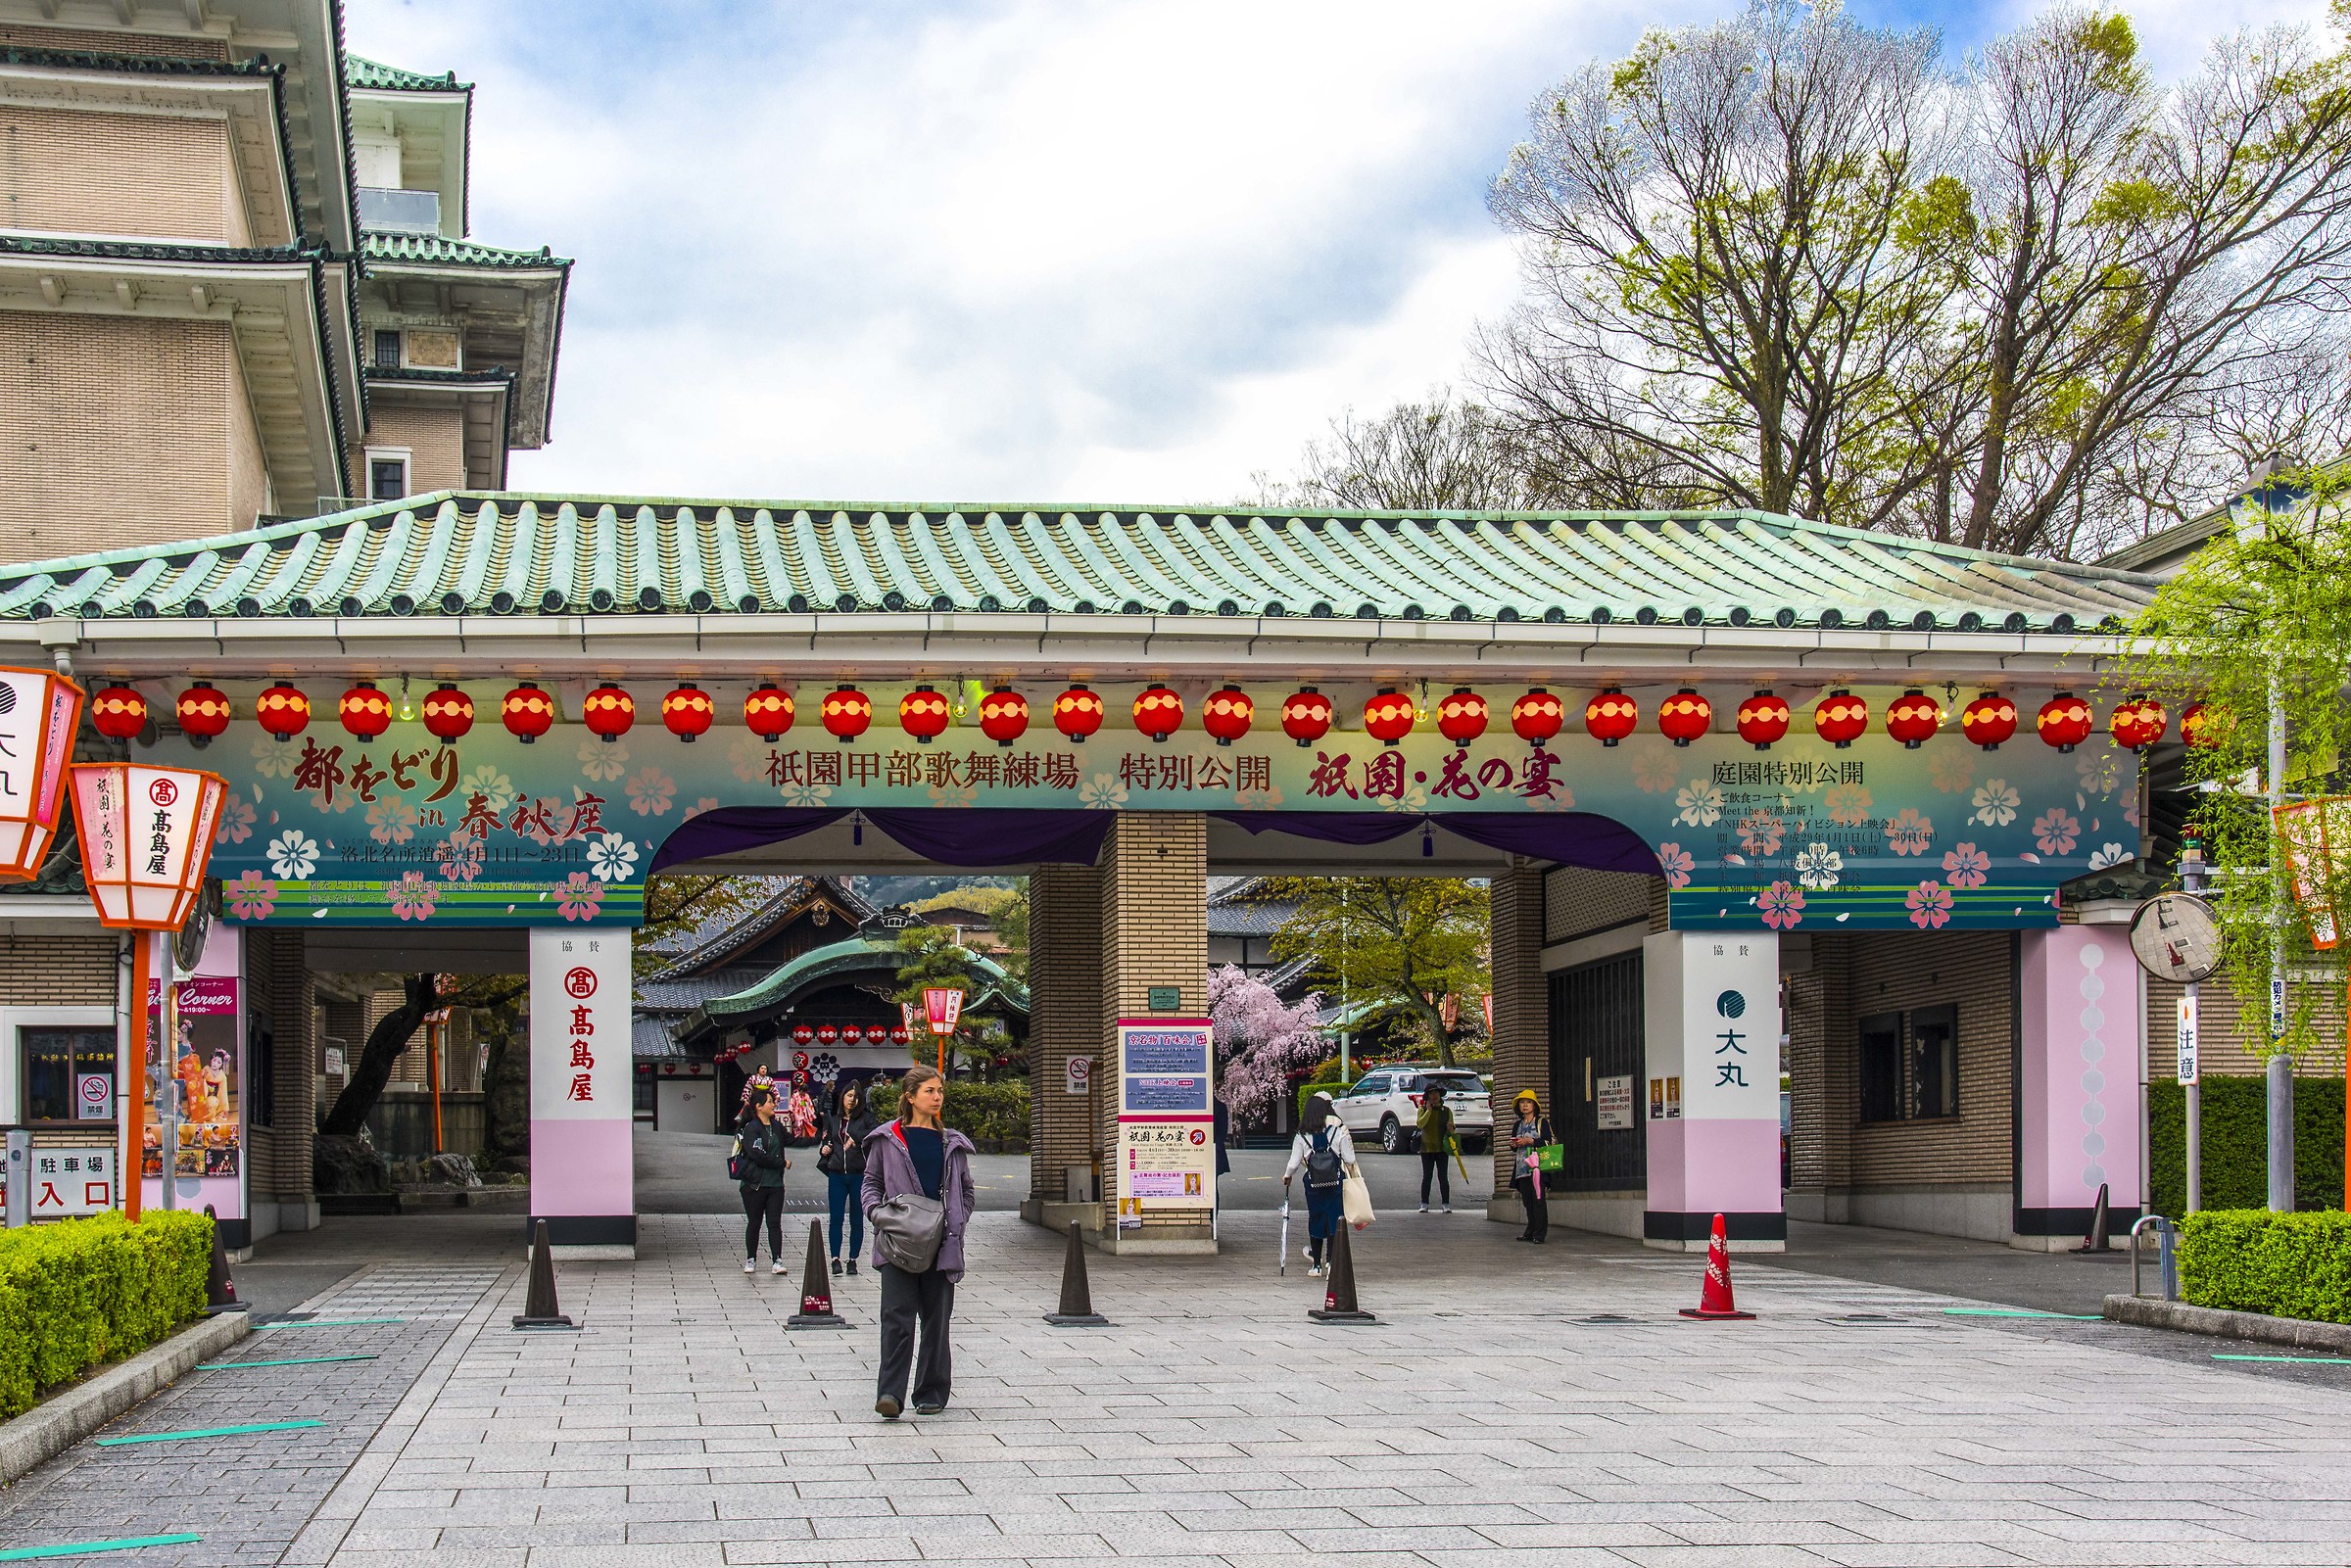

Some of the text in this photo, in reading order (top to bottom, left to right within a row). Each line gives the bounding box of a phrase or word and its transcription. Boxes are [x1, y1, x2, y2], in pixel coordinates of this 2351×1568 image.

[294, 736, 459, 804] 都をどり
[765, 750, 1271, 792] 祇園甲部歌舞練場 特別公開
[1307, 747, 1564, 801] 祇園・花の宴
[1712, 761, 1863, 785] 庭園特別公開
[418, 791, 607, 839] in 春秋座
[1717, 845, 1765, 855] 営業時間
[179, 988, 233, 1006] Corner
[1715, 1027, 1749, 1088] 大丸
[2180, 1028, 2193, 1079] 注意
[86, 1105, 104, 1114] 禁煙
[40, 1156, 104, 1173] 駐車場
[37, 1181, 110, 1208] 入口
